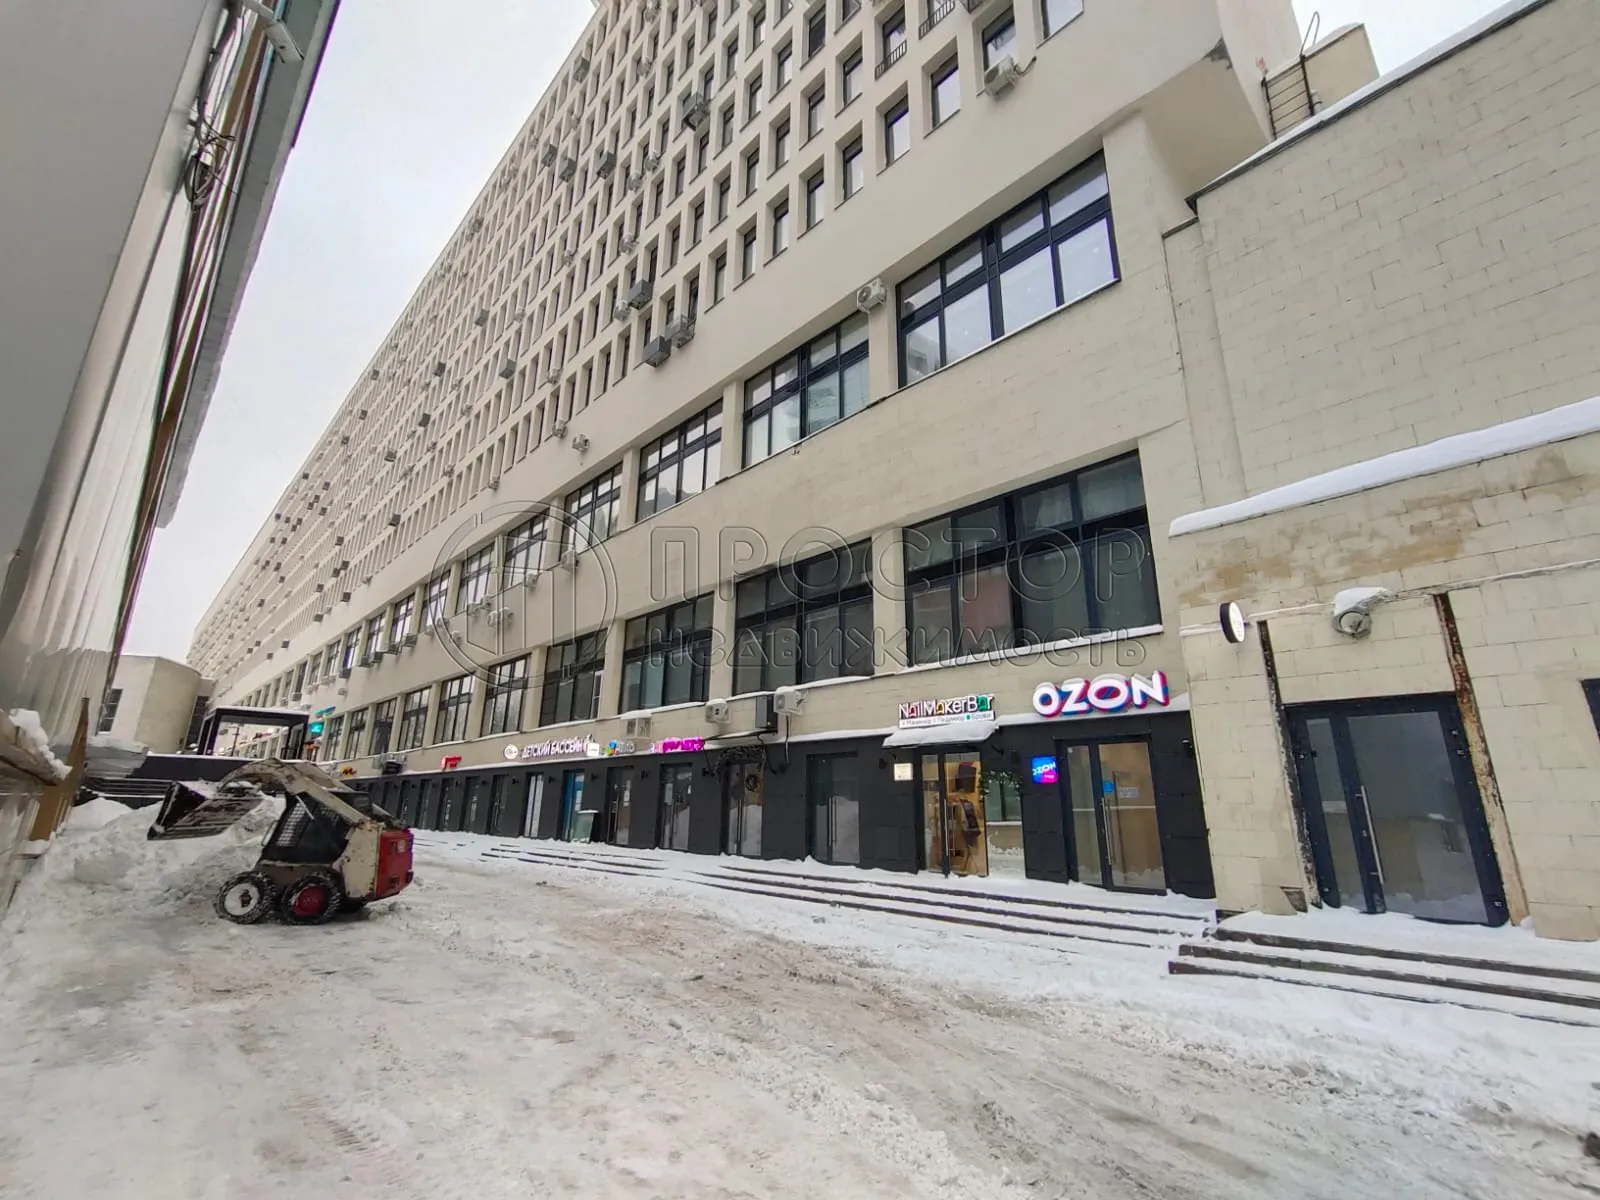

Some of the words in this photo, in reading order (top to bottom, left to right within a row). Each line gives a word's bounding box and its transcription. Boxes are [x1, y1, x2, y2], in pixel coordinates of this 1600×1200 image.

[1033, 670, 1169, 717] OZON
[522, 740, 551, 759] ДЕТСКИЙ
[551, 737, 583, 755] БАССЕЙН
